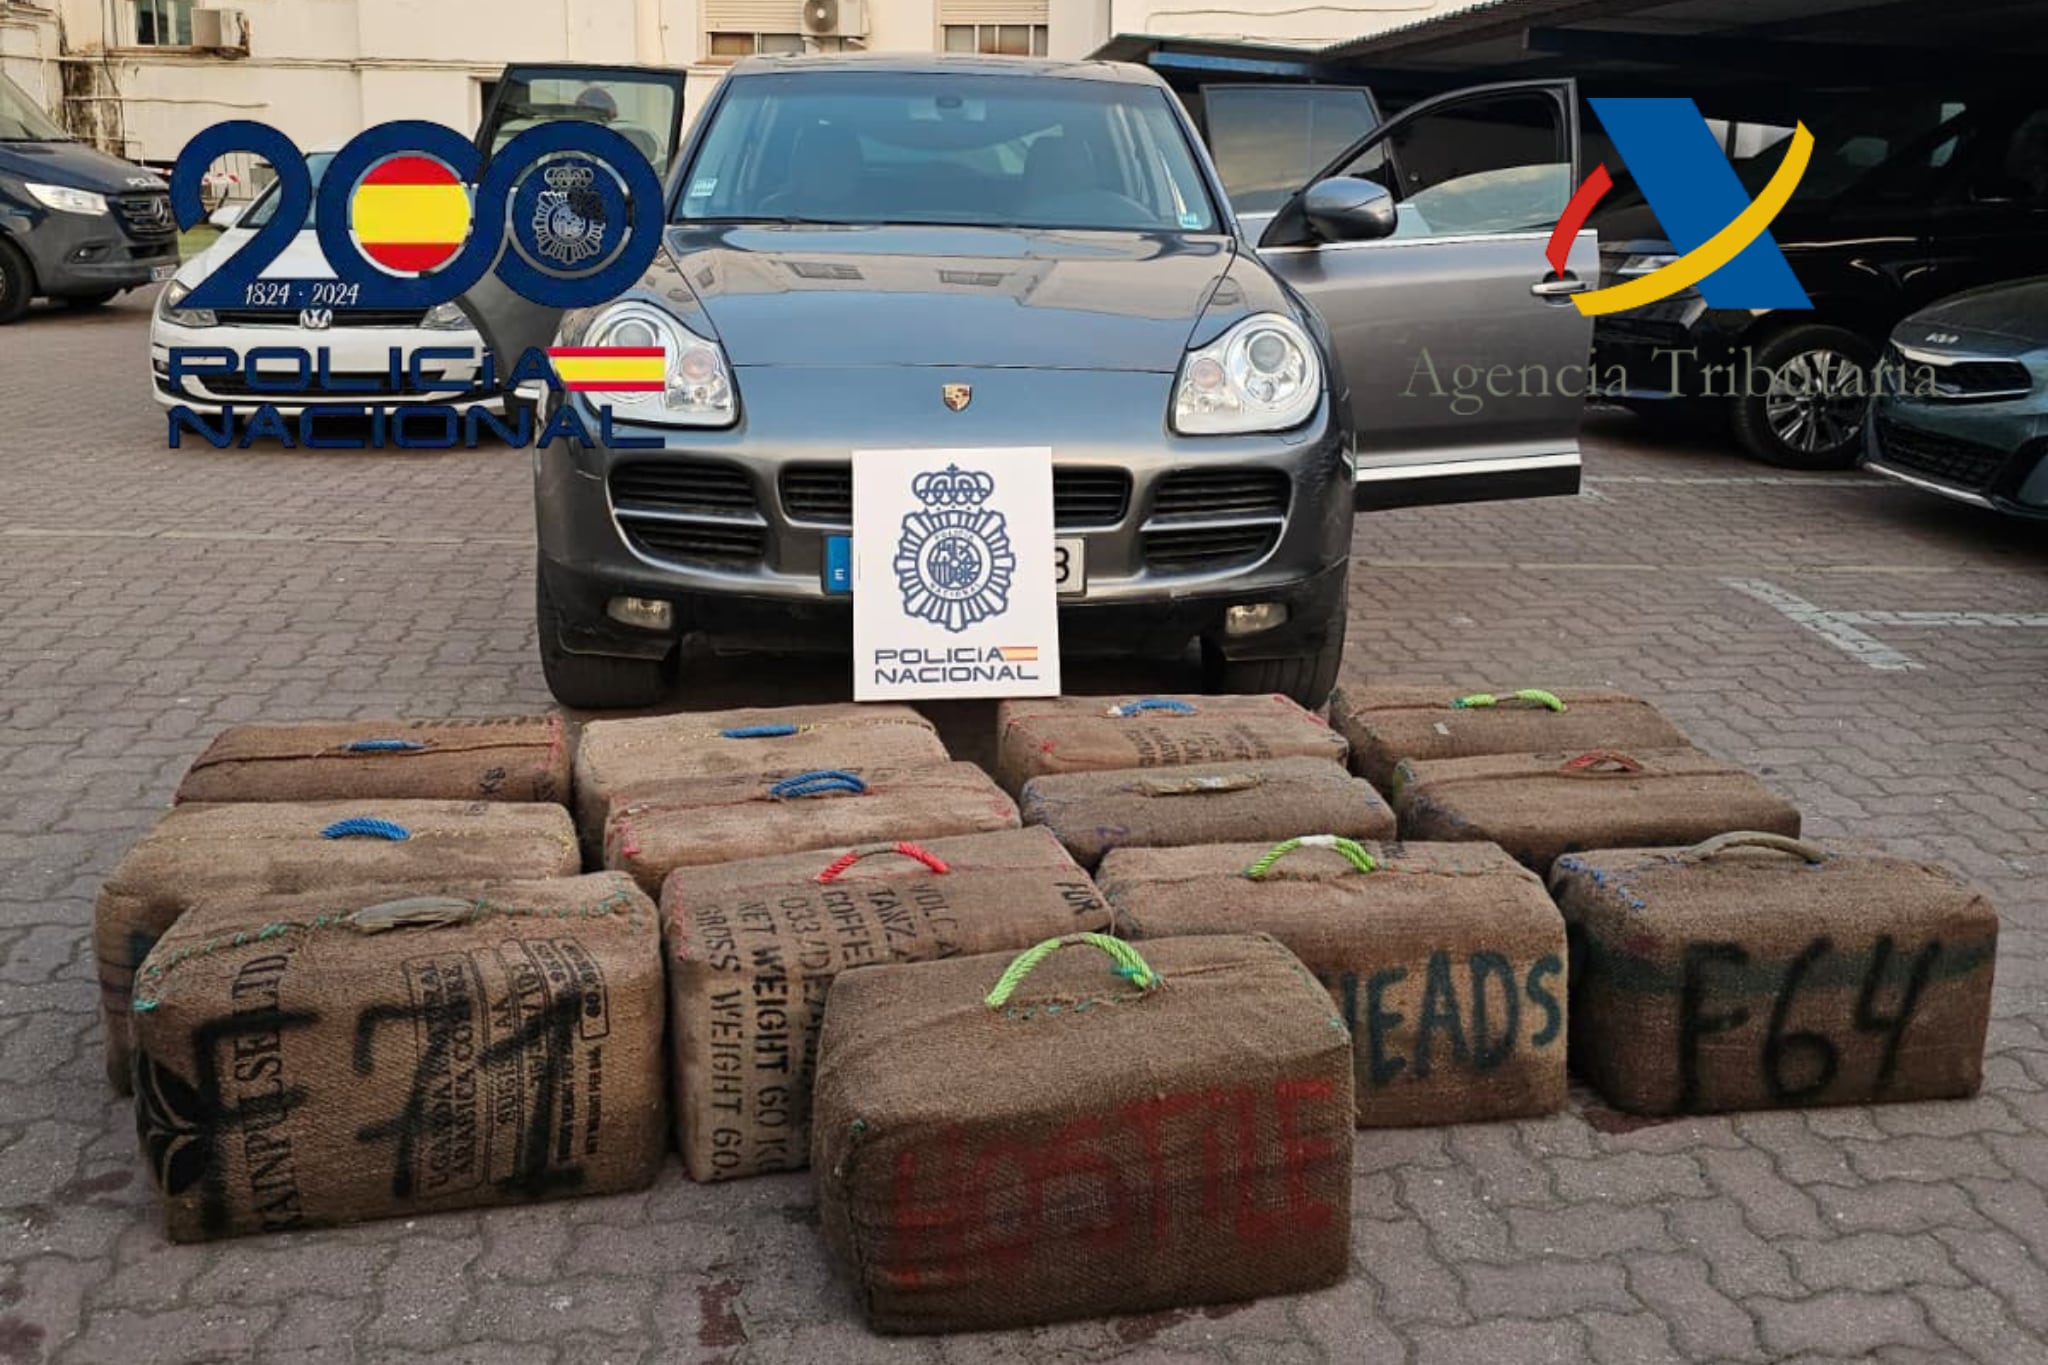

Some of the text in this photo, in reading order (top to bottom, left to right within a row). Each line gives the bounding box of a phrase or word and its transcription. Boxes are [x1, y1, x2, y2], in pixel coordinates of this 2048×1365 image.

[875, 665, 1038, 685] NACIONAL
[738, 902, 777, 936] NET
[751, 947, 789, 1075] WEIGHT
[709, 989, 744, 1116] WEIGHT
